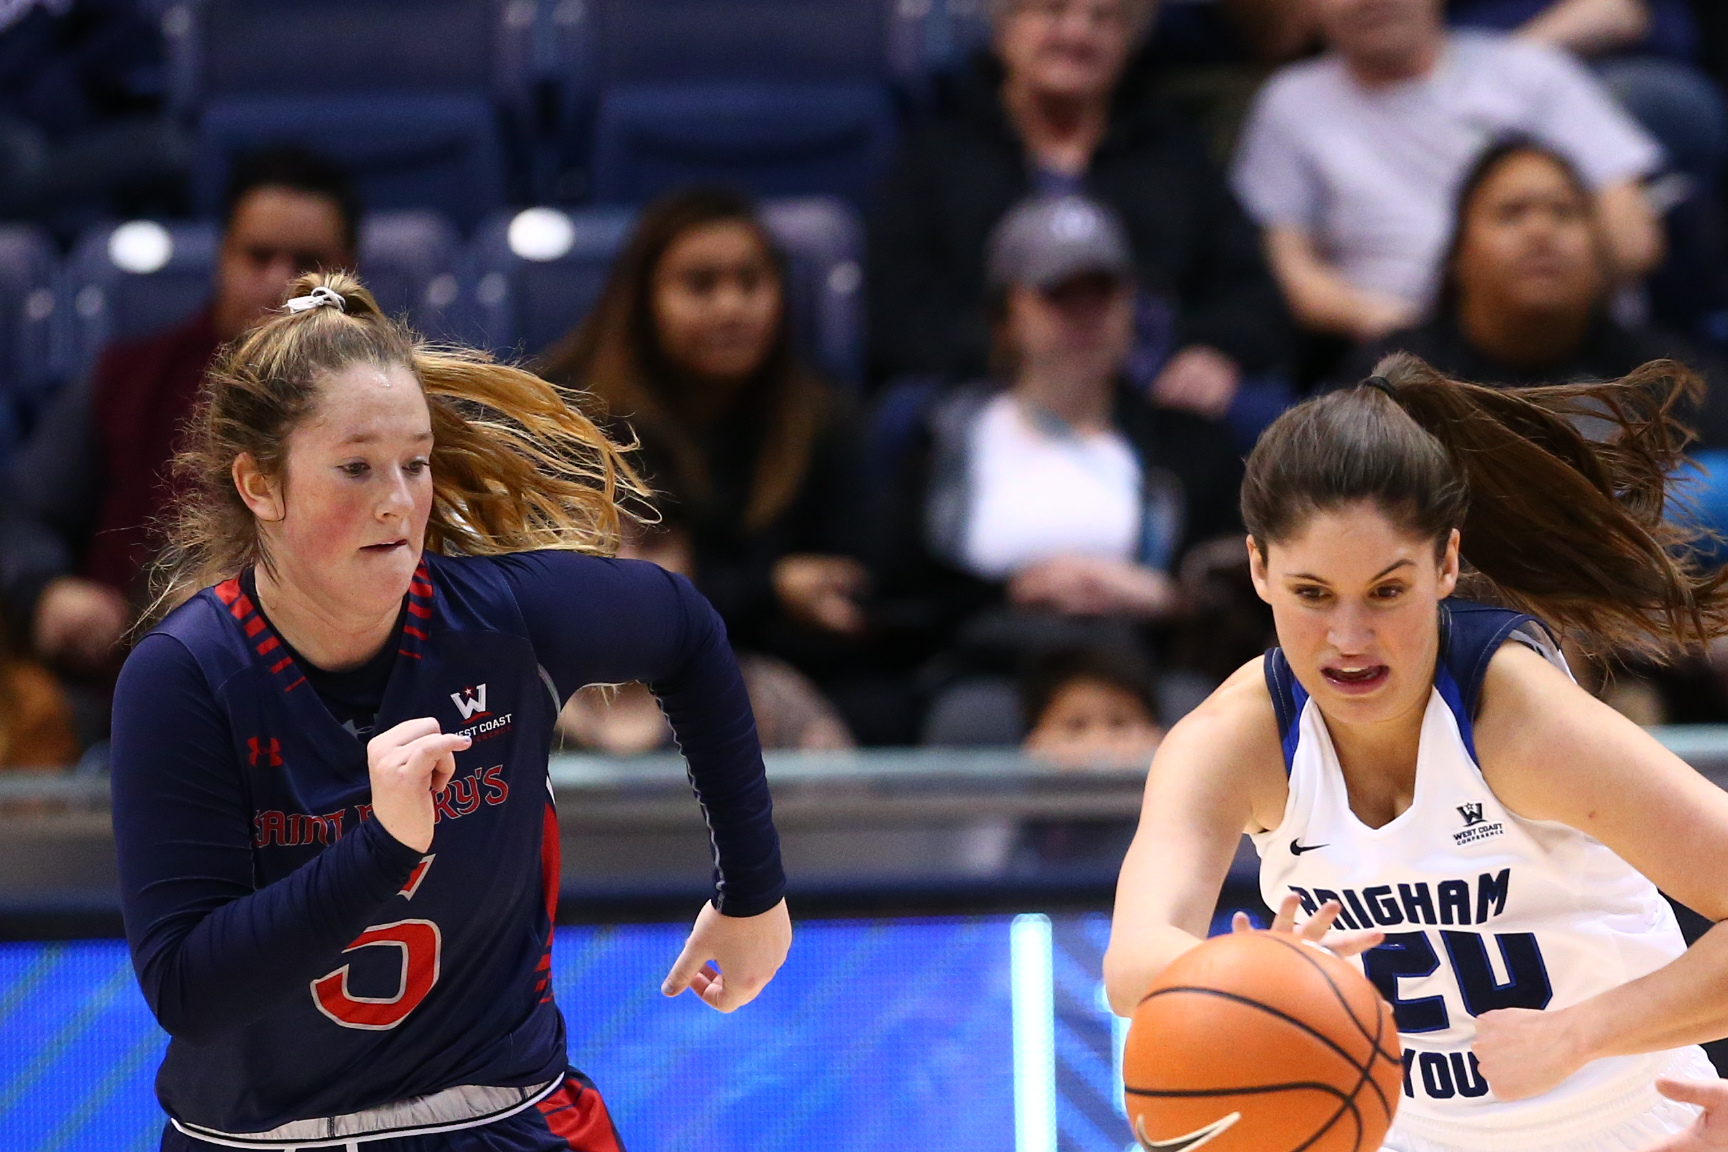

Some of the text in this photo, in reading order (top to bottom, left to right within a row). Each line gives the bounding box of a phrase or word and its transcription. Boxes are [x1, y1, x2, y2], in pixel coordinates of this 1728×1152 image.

[479, 713, 512, 733] COAST
[1453, 823, 1502, 840] WEST COAST
